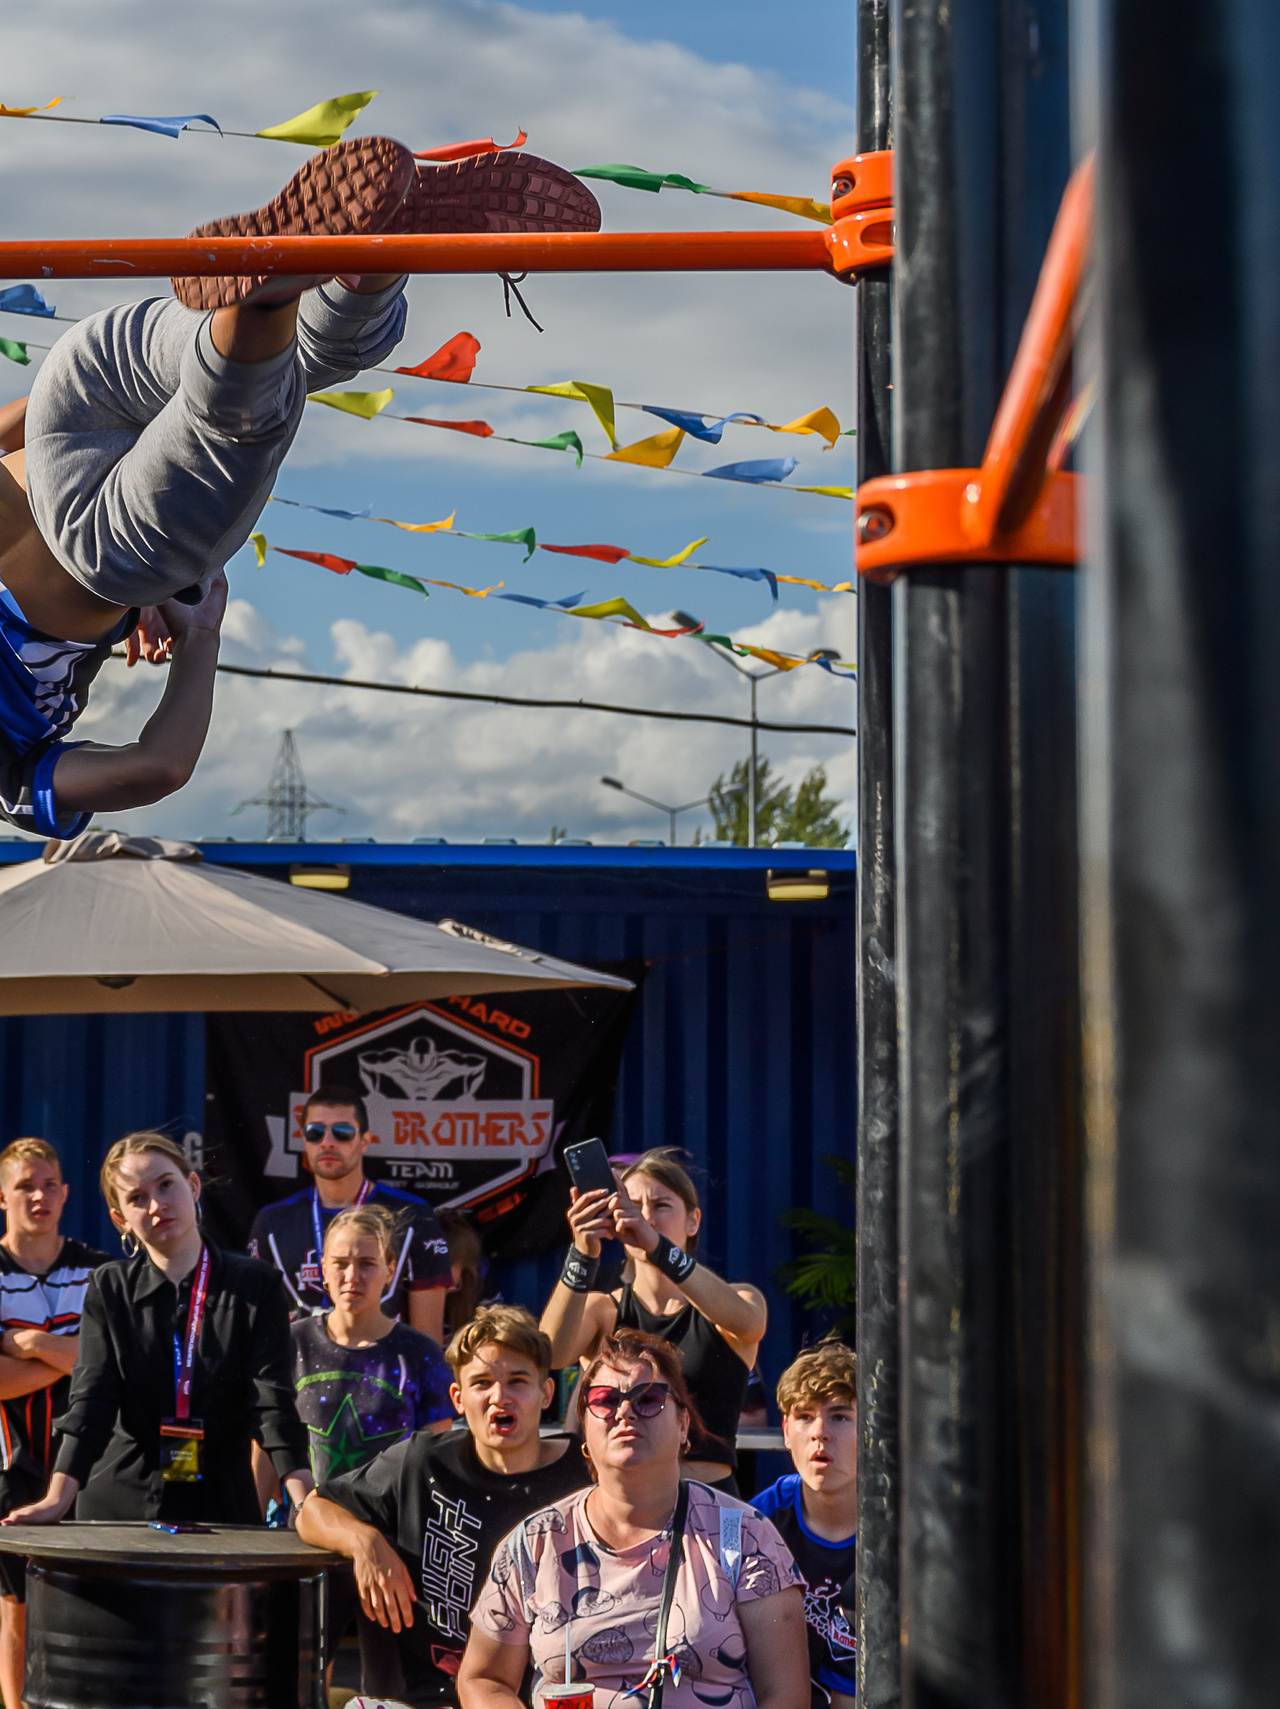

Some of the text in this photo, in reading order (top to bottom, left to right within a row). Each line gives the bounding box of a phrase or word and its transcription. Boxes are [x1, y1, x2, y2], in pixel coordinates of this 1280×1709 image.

[391, 1111, 550, 1147] BROTHERS
[386, 1160, 454, 1178] TEAM
[447, 1499, 482, 1641] POINT
